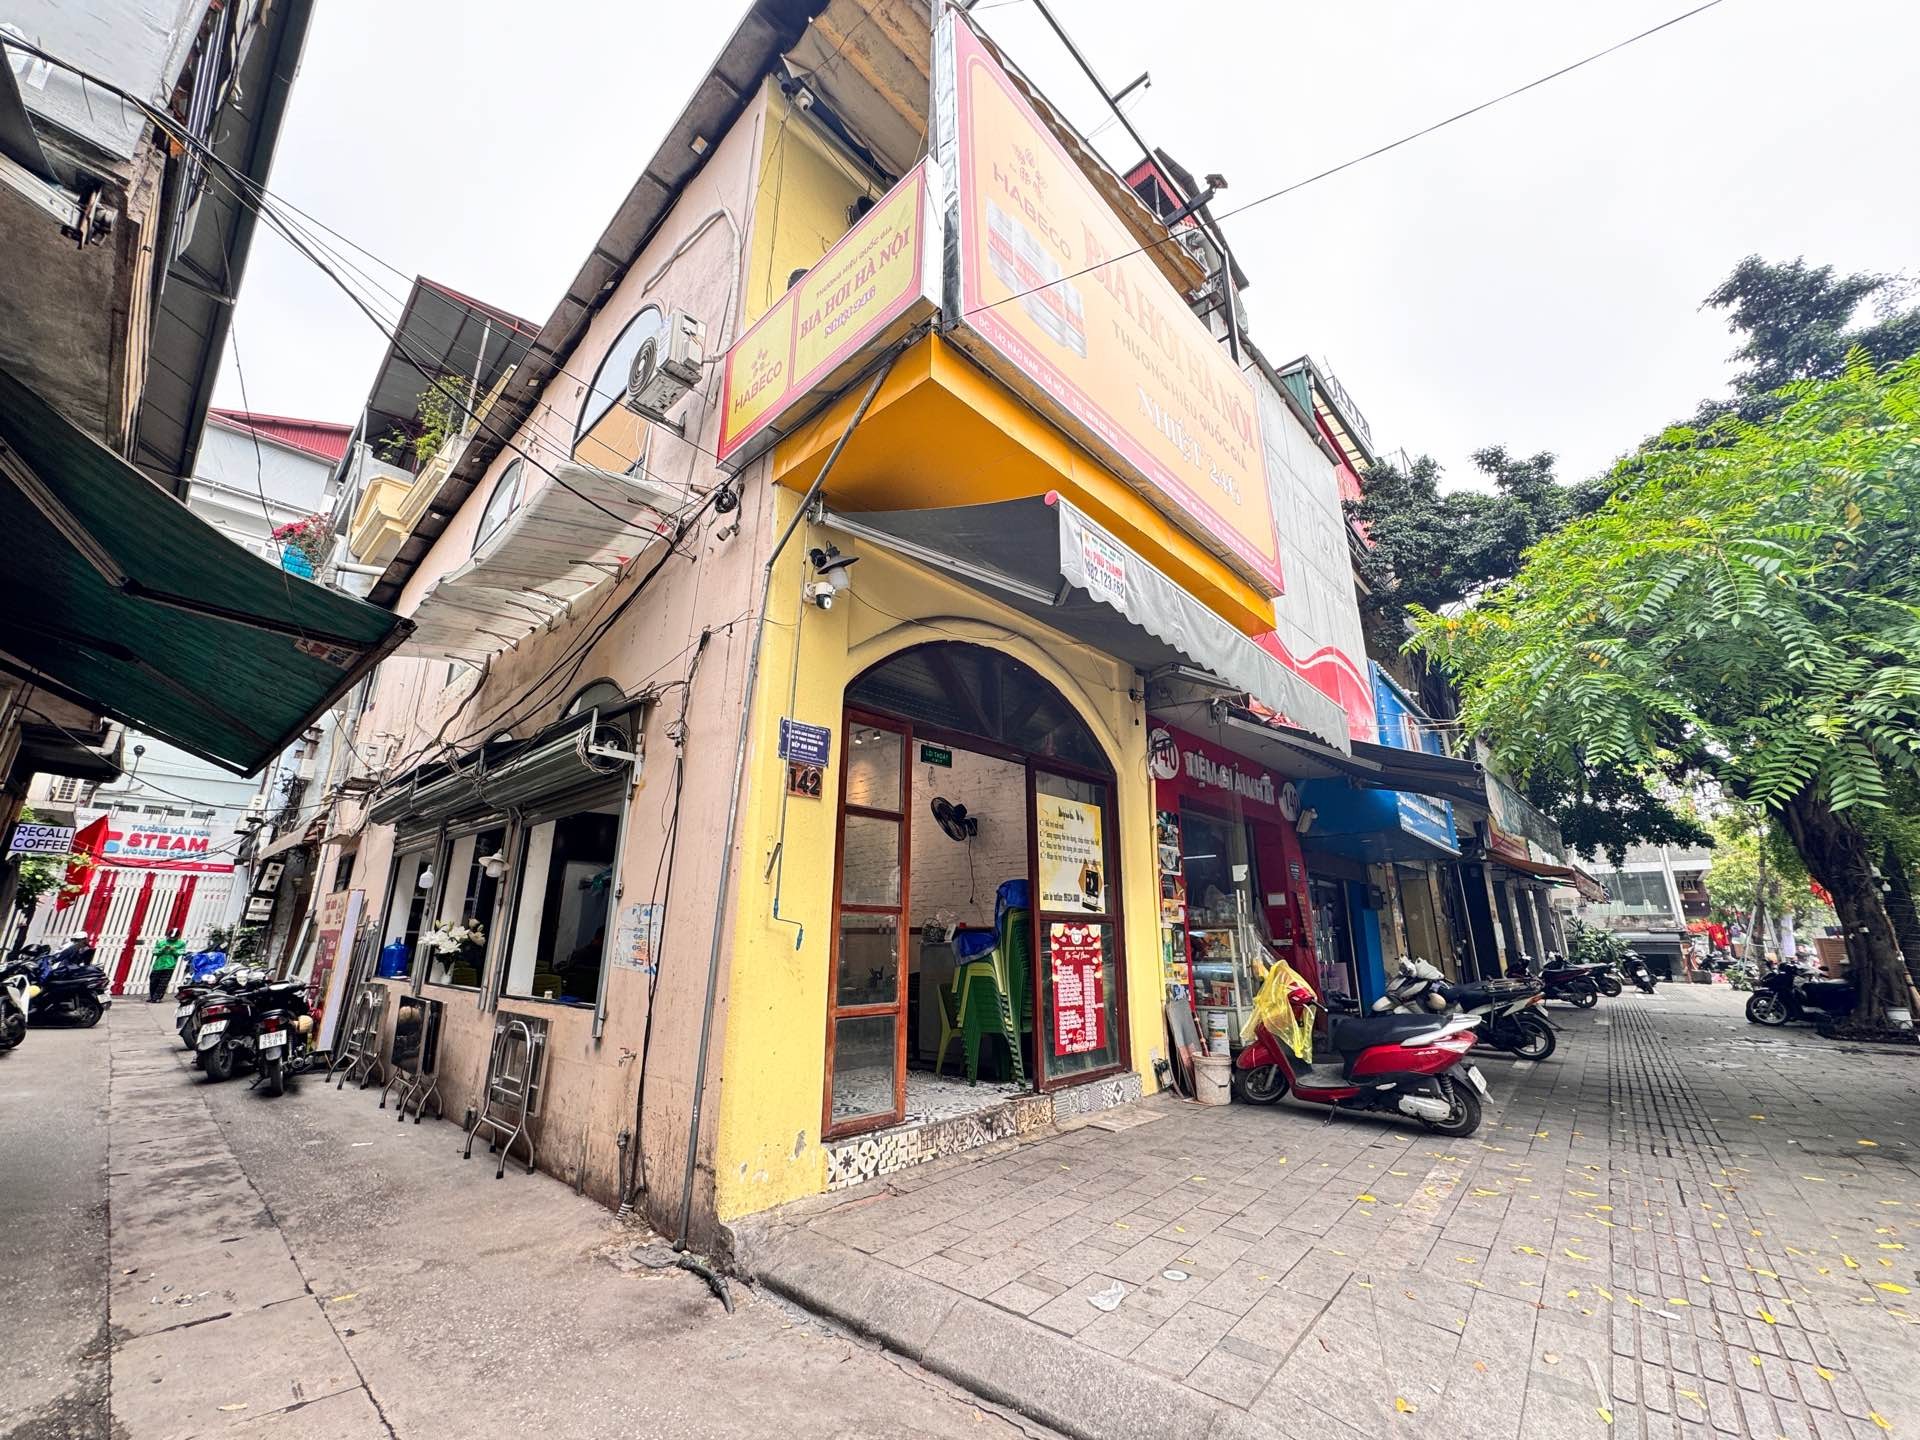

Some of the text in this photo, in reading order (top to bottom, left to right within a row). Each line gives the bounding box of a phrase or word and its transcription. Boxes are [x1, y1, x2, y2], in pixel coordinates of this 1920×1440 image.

[992, 161, 1073, 261] HABECO
[800, 310, 822, 341] BIA
[852, 257, 876, 299] HÀ
[877, 225, 911, 271] NỘI
[1080, 218, 1136, 321] BIA
[734, 360, 783, 414] HABECO
[789, 767, 821, 797] 142
[1183, 749, 1217, 788] TIỆM
[13, 837, 69, 851] COFFEE
[16, 825, 71, 840] RECALL
[127, 832, 210, 853] STEAM
[193, 829, 212, 837] NON
